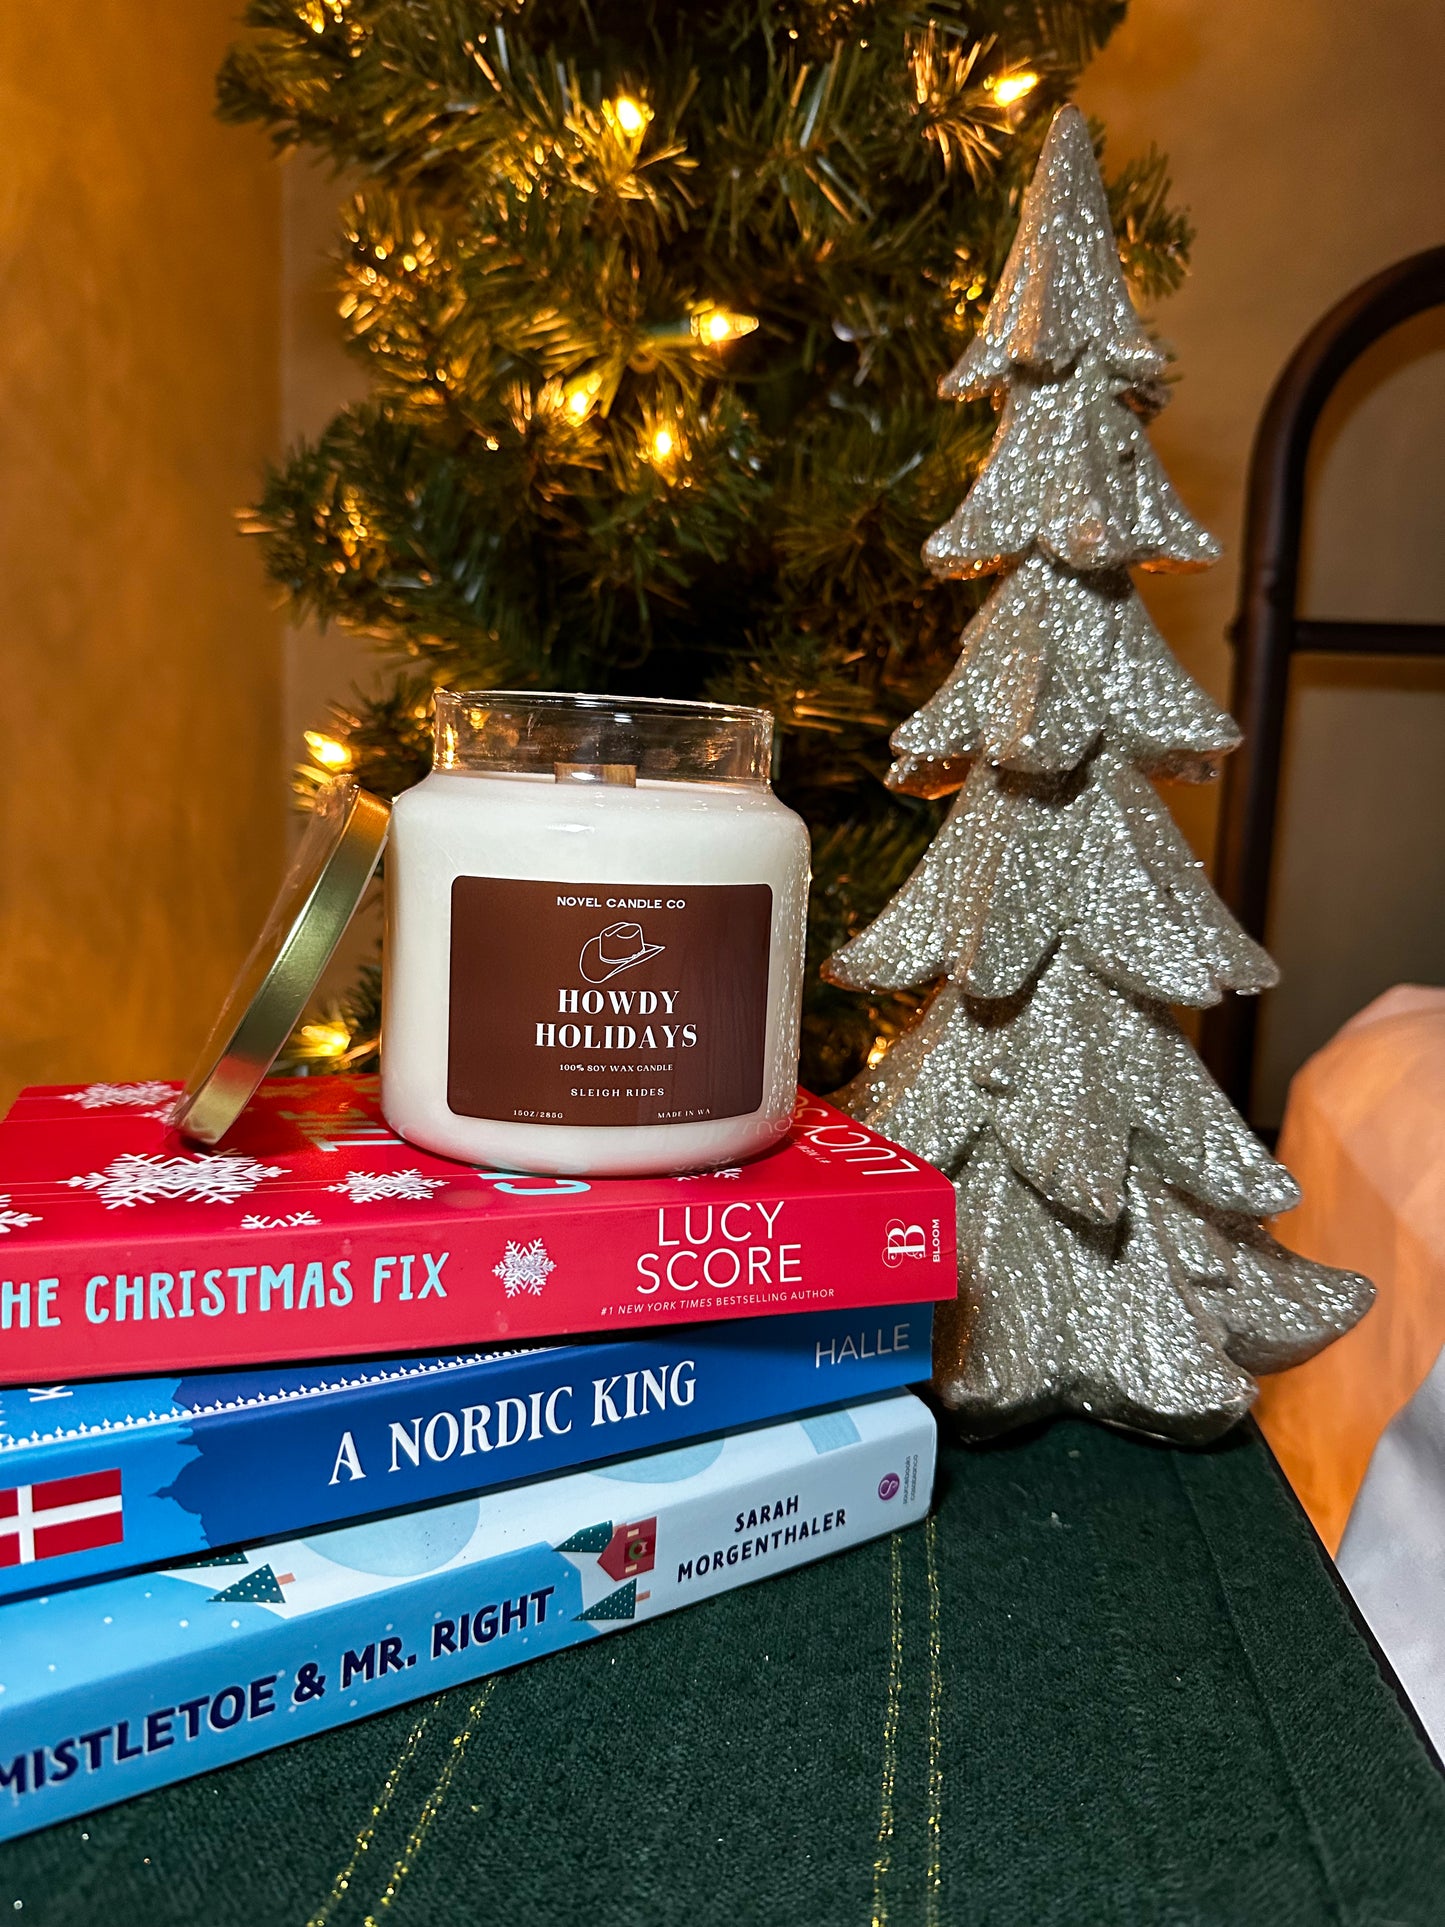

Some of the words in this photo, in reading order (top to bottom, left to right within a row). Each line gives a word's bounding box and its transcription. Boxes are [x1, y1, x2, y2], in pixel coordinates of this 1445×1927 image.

[557, 896, 602, 908] NOVEL
[606, 898, 662, 909] CANDLE
[666, 899, 686, 909] CO
[558, 989, 680, 1015] HOWDY
[534, 1022, 698, 1049] HOLIDAYS
[559, 1064, 585, 1072] 100%
[587, 1064, 606, 1072] SOY
[609, 1064, 635, 1072] WAX
[636, 1063, 673, 1072] CANDLE
[570, 1088, 620, 1097] SLEIGH
[626, 1087, 665, 1097] RIDES
[657, 1110, 682, 1118] MADE
[658, 1200, 784, 1247] LUCY
[932, 1219, 941, 1263] BLOOM
[636, 1244, 802, 1295] SCORE
[0, 1278, 61, 1329] HE
[85, 1260, 353, 1323] CHRISTMAS
[373, 1252, 451, 1303] FIX
[601, 1307, 613, 1315] #1
[618, 1304, 644, 1314] NEW
[647, 1301, 676, 1312] YORK
[680, 1298, 712, 1309] TIMES
[716, 1292, 787, 1306] BESTSELLING
[790, 1288, 835, 1300] AUTHOR
[815, 1323, 910, 1368] HALLE
[328, 1431, 366, 1485] A
[388, 1386, 573, 1473] NORDIC
[590, 1360, 696, 1427] KING
[734, 1495, 799, 1533] SARAH
[677, 1508, 846, 1583] MORGENTHALER
[0, 1674, 278, 1796] MISTLETOE
[290, 1662, 326, 1704] &
[340, 1636, 417, 1691] MR.
[431, 1585, 555, 1660] RIGHT
